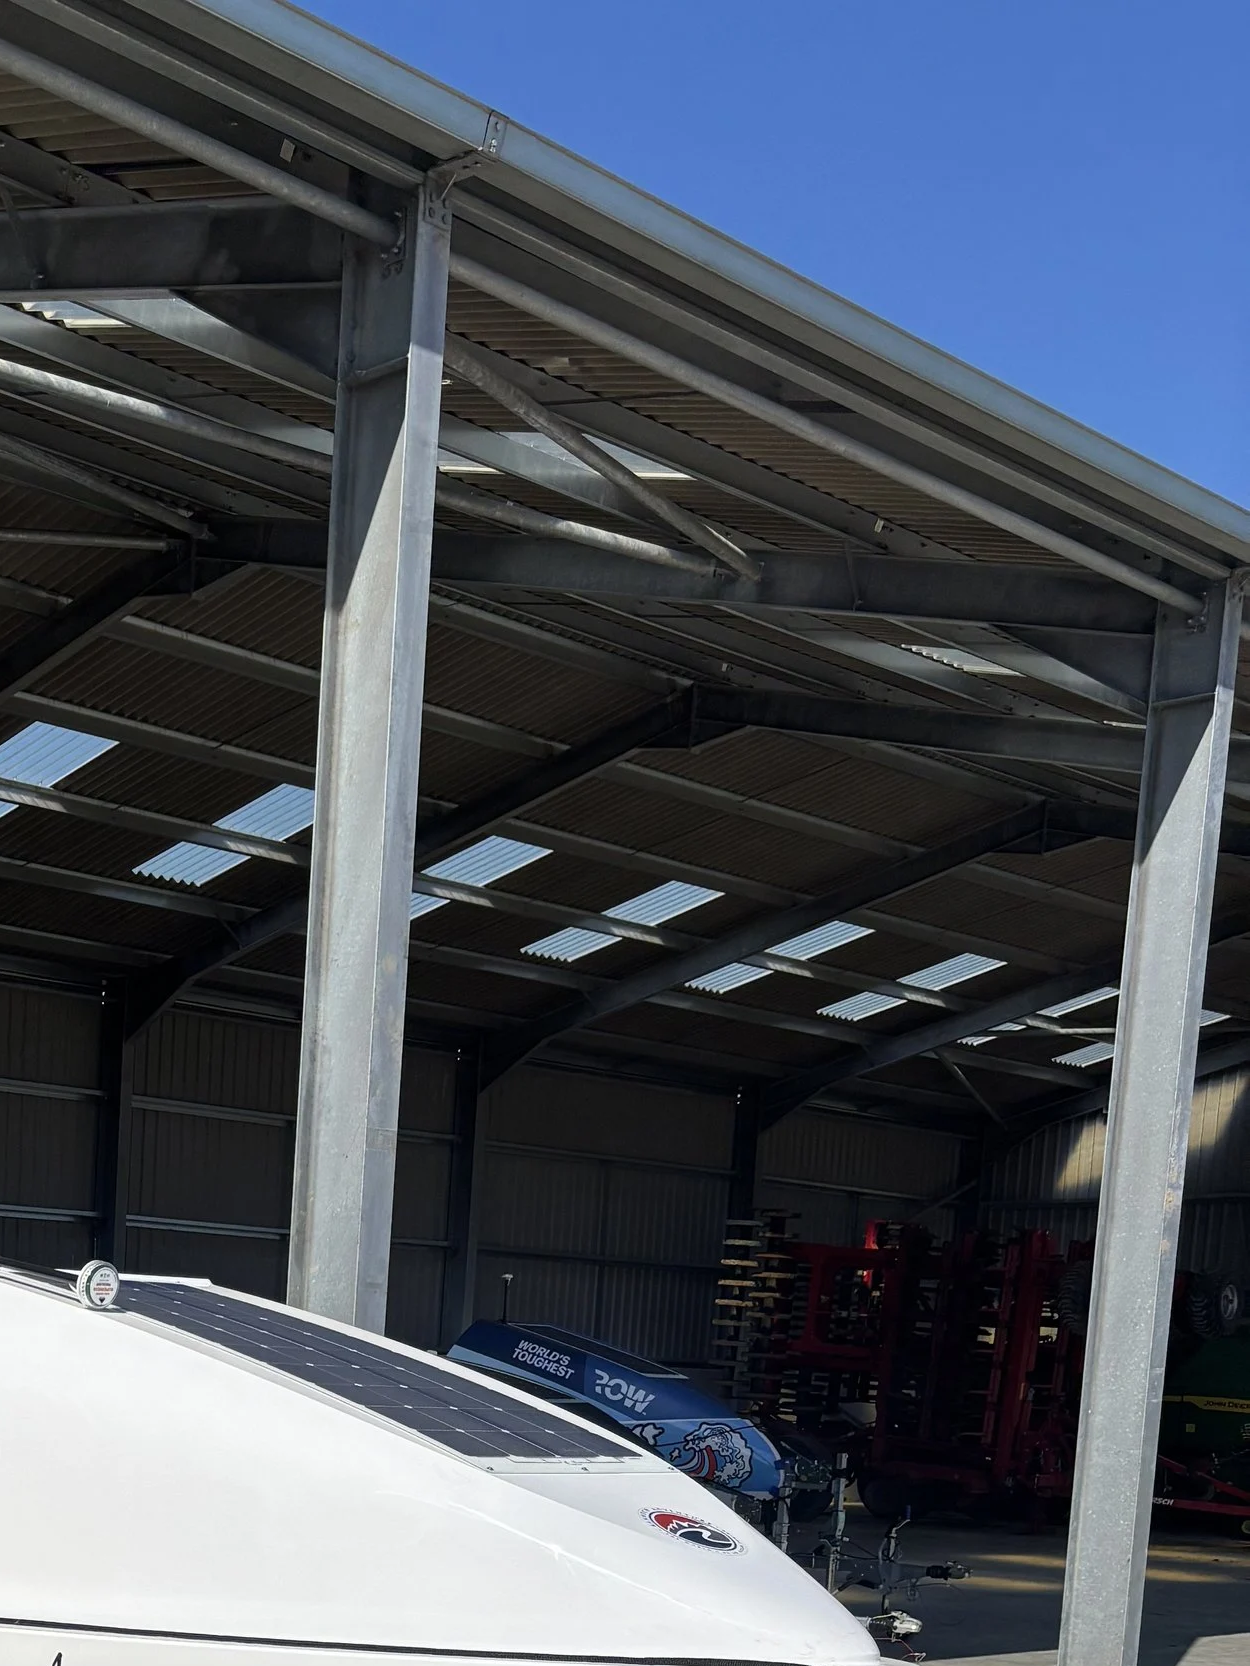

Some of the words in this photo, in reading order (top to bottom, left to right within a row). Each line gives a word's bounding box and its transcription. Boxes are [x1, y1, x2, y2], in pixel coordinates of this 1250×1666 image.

[513, 1348, 574, 1379] TOUGHEST
[518, 1340, 571, 1366] WORLD'S
[595, 1369, 655, 1413] ROW
